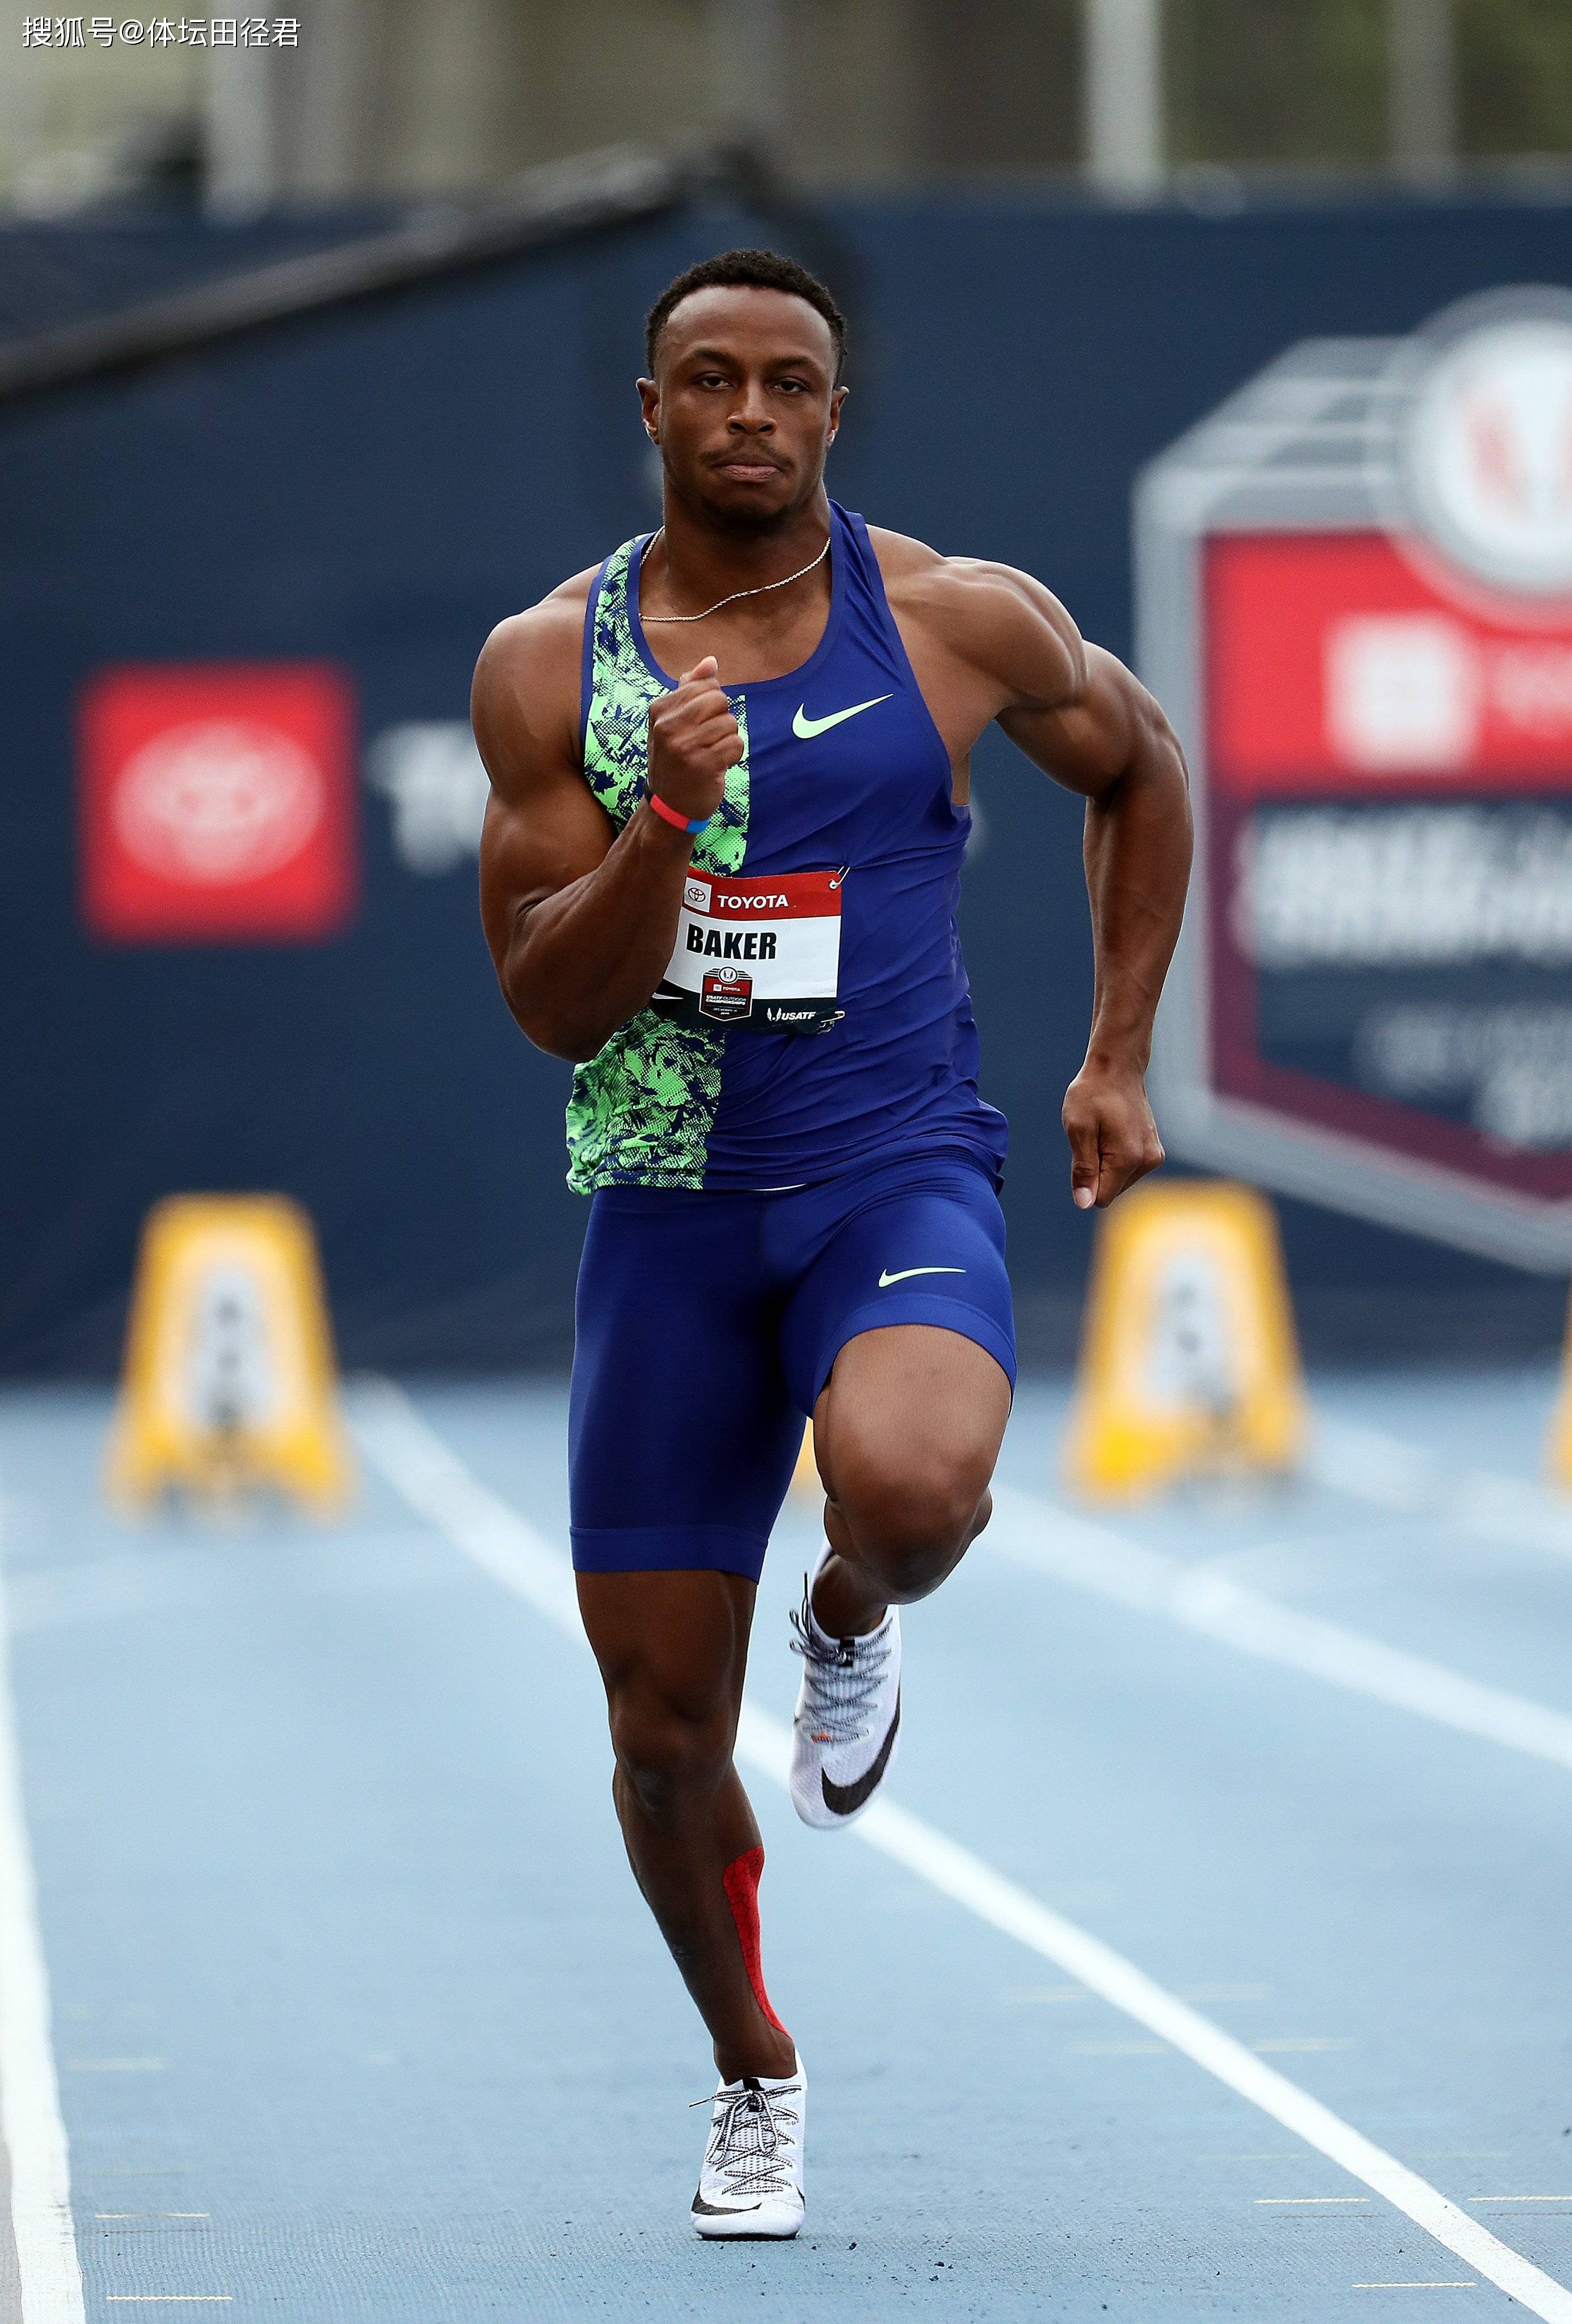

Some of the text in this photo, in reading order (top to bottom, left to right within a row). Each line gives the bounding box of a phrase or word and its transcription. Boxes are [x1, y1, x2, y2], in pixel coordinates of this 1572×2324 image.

[717, 894, 789, 909] TOYOTA
[686, 923, 777, 959] BAKER
[781, 1012, 817, 1021] USATF
